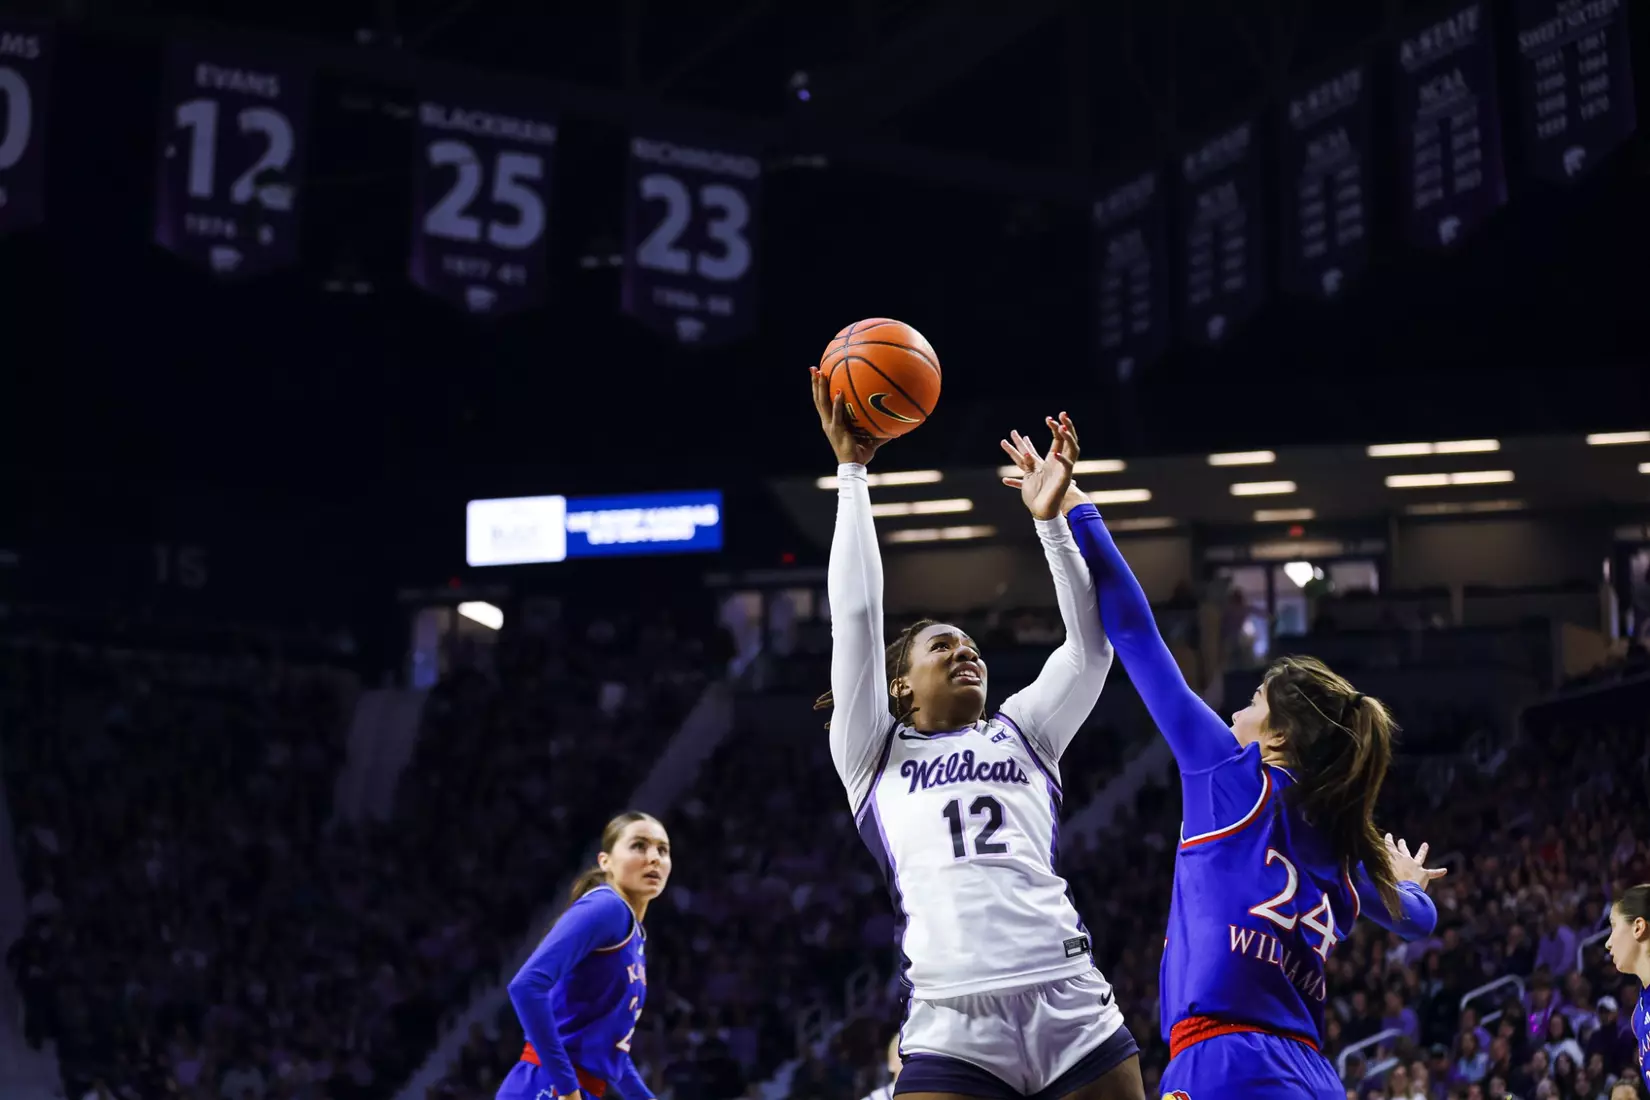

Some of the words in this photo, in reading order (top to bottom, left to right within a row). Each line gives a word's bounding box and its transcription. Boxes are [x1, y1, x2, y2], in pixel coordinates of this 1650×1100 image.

[195, 61, 281, 98] EVANS
[174, 96, 296, 210] 12
[417, 100, 558, 147] BLACKMAN
[424, 138, 547, 252] 25
[635, 172, 752, 283] 23
[900, 749, 1030, 793] Wildcats
[942, 795, 1010, 859] 12
[1248, 846, 1339, 963] 24
